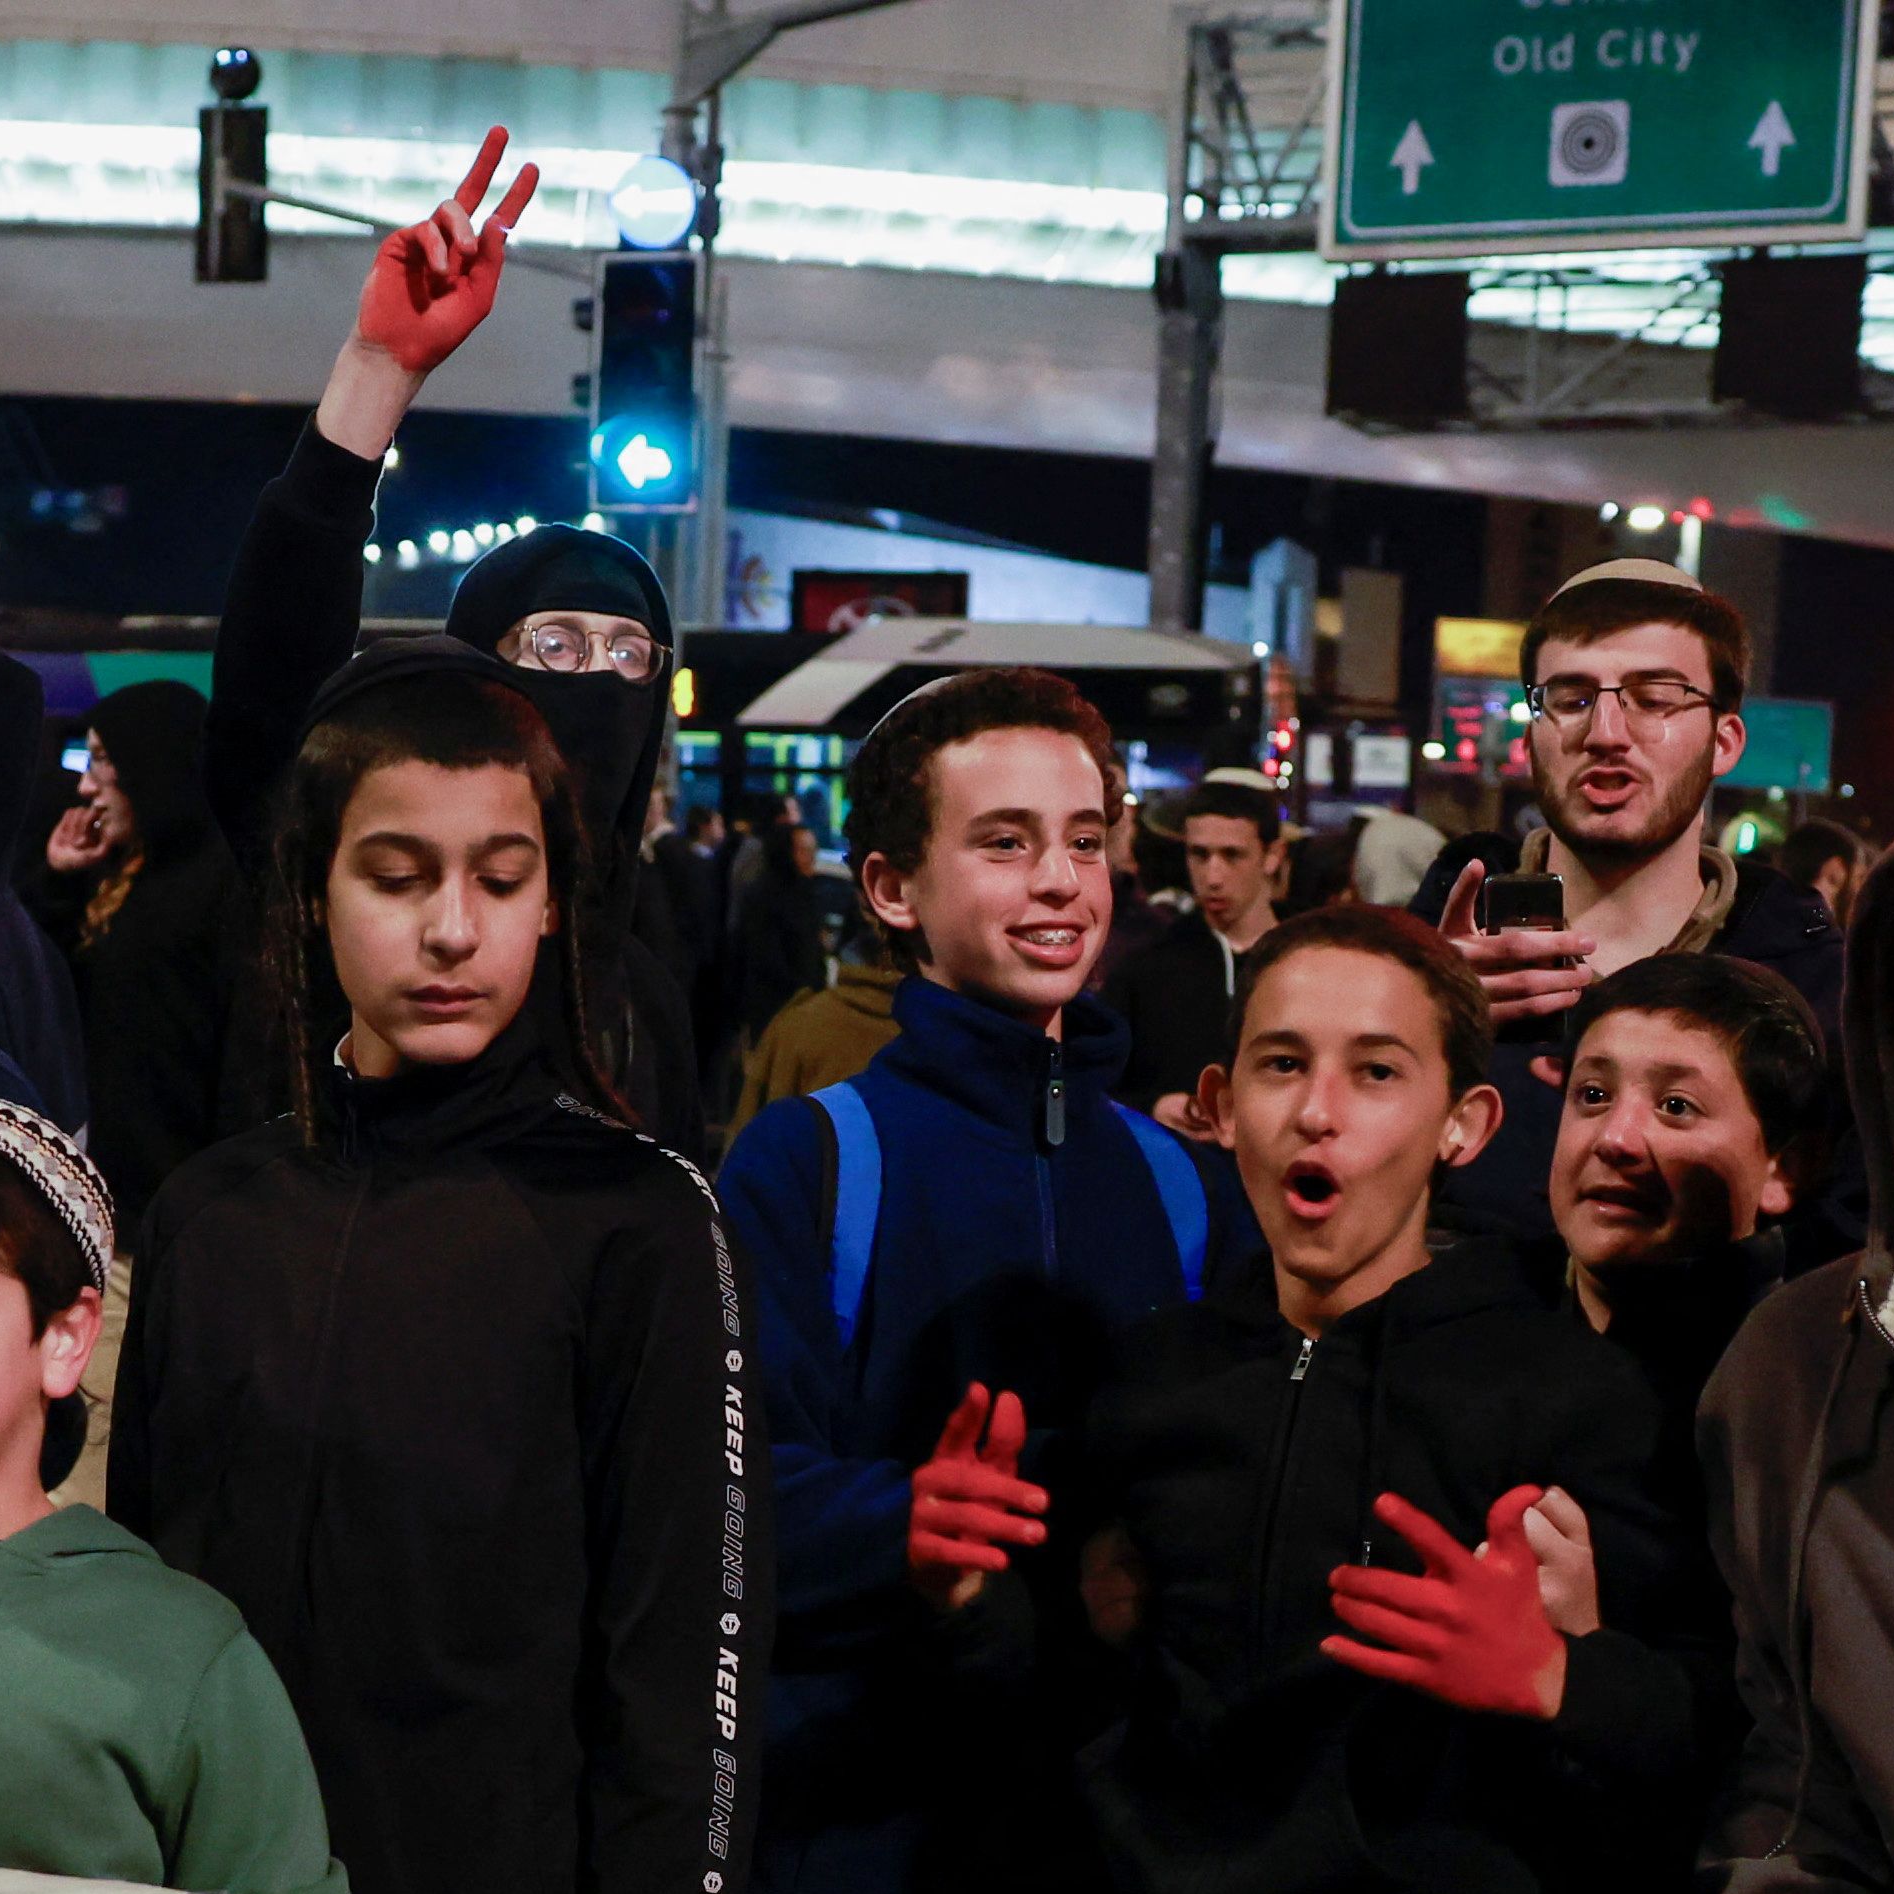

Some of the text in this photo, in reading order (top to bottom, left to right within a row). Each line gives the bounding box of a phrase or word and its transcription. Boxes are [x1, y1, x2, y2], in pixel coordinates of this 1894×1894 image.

[1493, 27, 1700, 75] Old City
[711, 1221, 740, 1338] GOING
[722, 1383, 746, 1600] KEEP GOING
[709, 1646, 740, 1860] KEEP GOING
